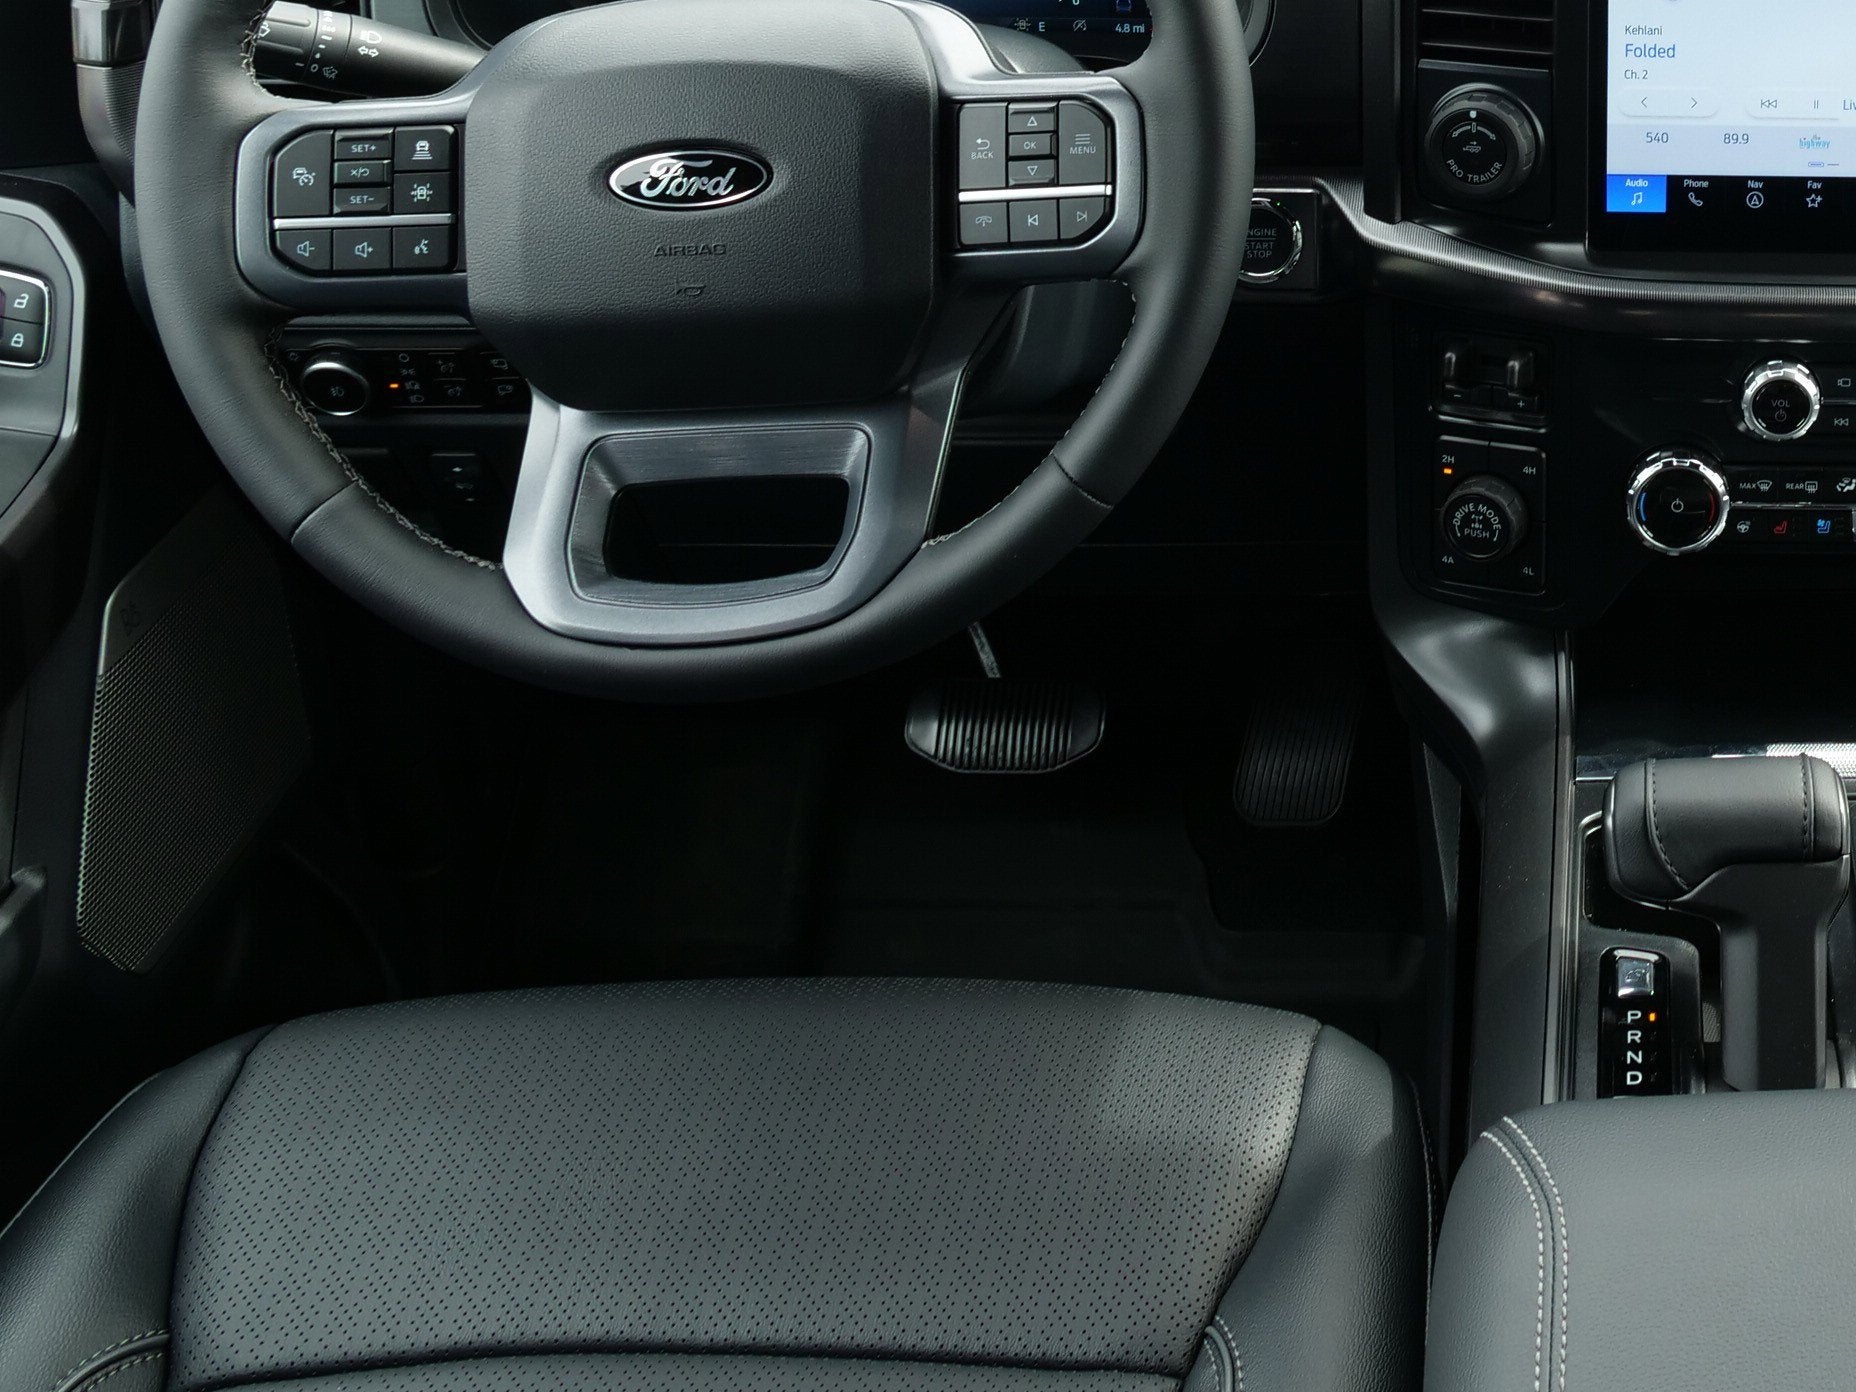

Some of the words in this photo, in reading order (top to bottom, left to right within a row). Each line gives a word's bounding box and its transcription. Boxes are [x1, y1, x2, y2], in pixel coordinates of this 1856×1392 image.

[1039, 21, 1046, 32] E
[1115, 23, 1131, 33] 4.8
[1132, 23, 1145, 33] mi
[1624, 25, 1663, 36] Kehlani
[1625, 44, 1676, 58] Folded
[1624, 70, 1640, 80] Ch.
[1642, 70, 1649, 80] 2
[1645, 132, 1669, 144] 540
[1723, 133, 1749, 145] 89.9
[1023, 141, 1037, 150] OK
[1069, 144, 1096, 155] MENU
[970, 150, 994, 160] BACK
[1446, 159, 1464, 178] PRO
[1467, 162, 1503, 184] TRAILER
[639, 157, 737, 198] Ford
[1625, 178, 1648, 188] Audio
[1683, 179, 1709, 188] Phone
[1747, 180, 1763, 189] Nav
[1807, 181, 1822, 189] Fav
[1248, 228, 1277, 237] NGINE
[653, 243, 727, 258] AIRBAG
[1245, 241, 1274, 250] START
[1247, 250, 1272, 258] STOP
[1771, 399, 1791, 408] VOL
[1442, 455, 1455, 464] 2H
[1522, 466, 1537, 475] 4H
[1453, 502, 1476, 526] DRIVE
[1478, 503, 1502, 530] MODE
[1464, 528, 1490, 539] PUSH
[1442, 555, 1454, 564] 4A
[1522, 566, 1535, 576] 4L
[1627, 1010, 1642, 1024] P
[1627, 1030, 1642, 1044] R
[1626, 1050, 1643, 1065] N
[1626, 1071, 1643, 1086] D
